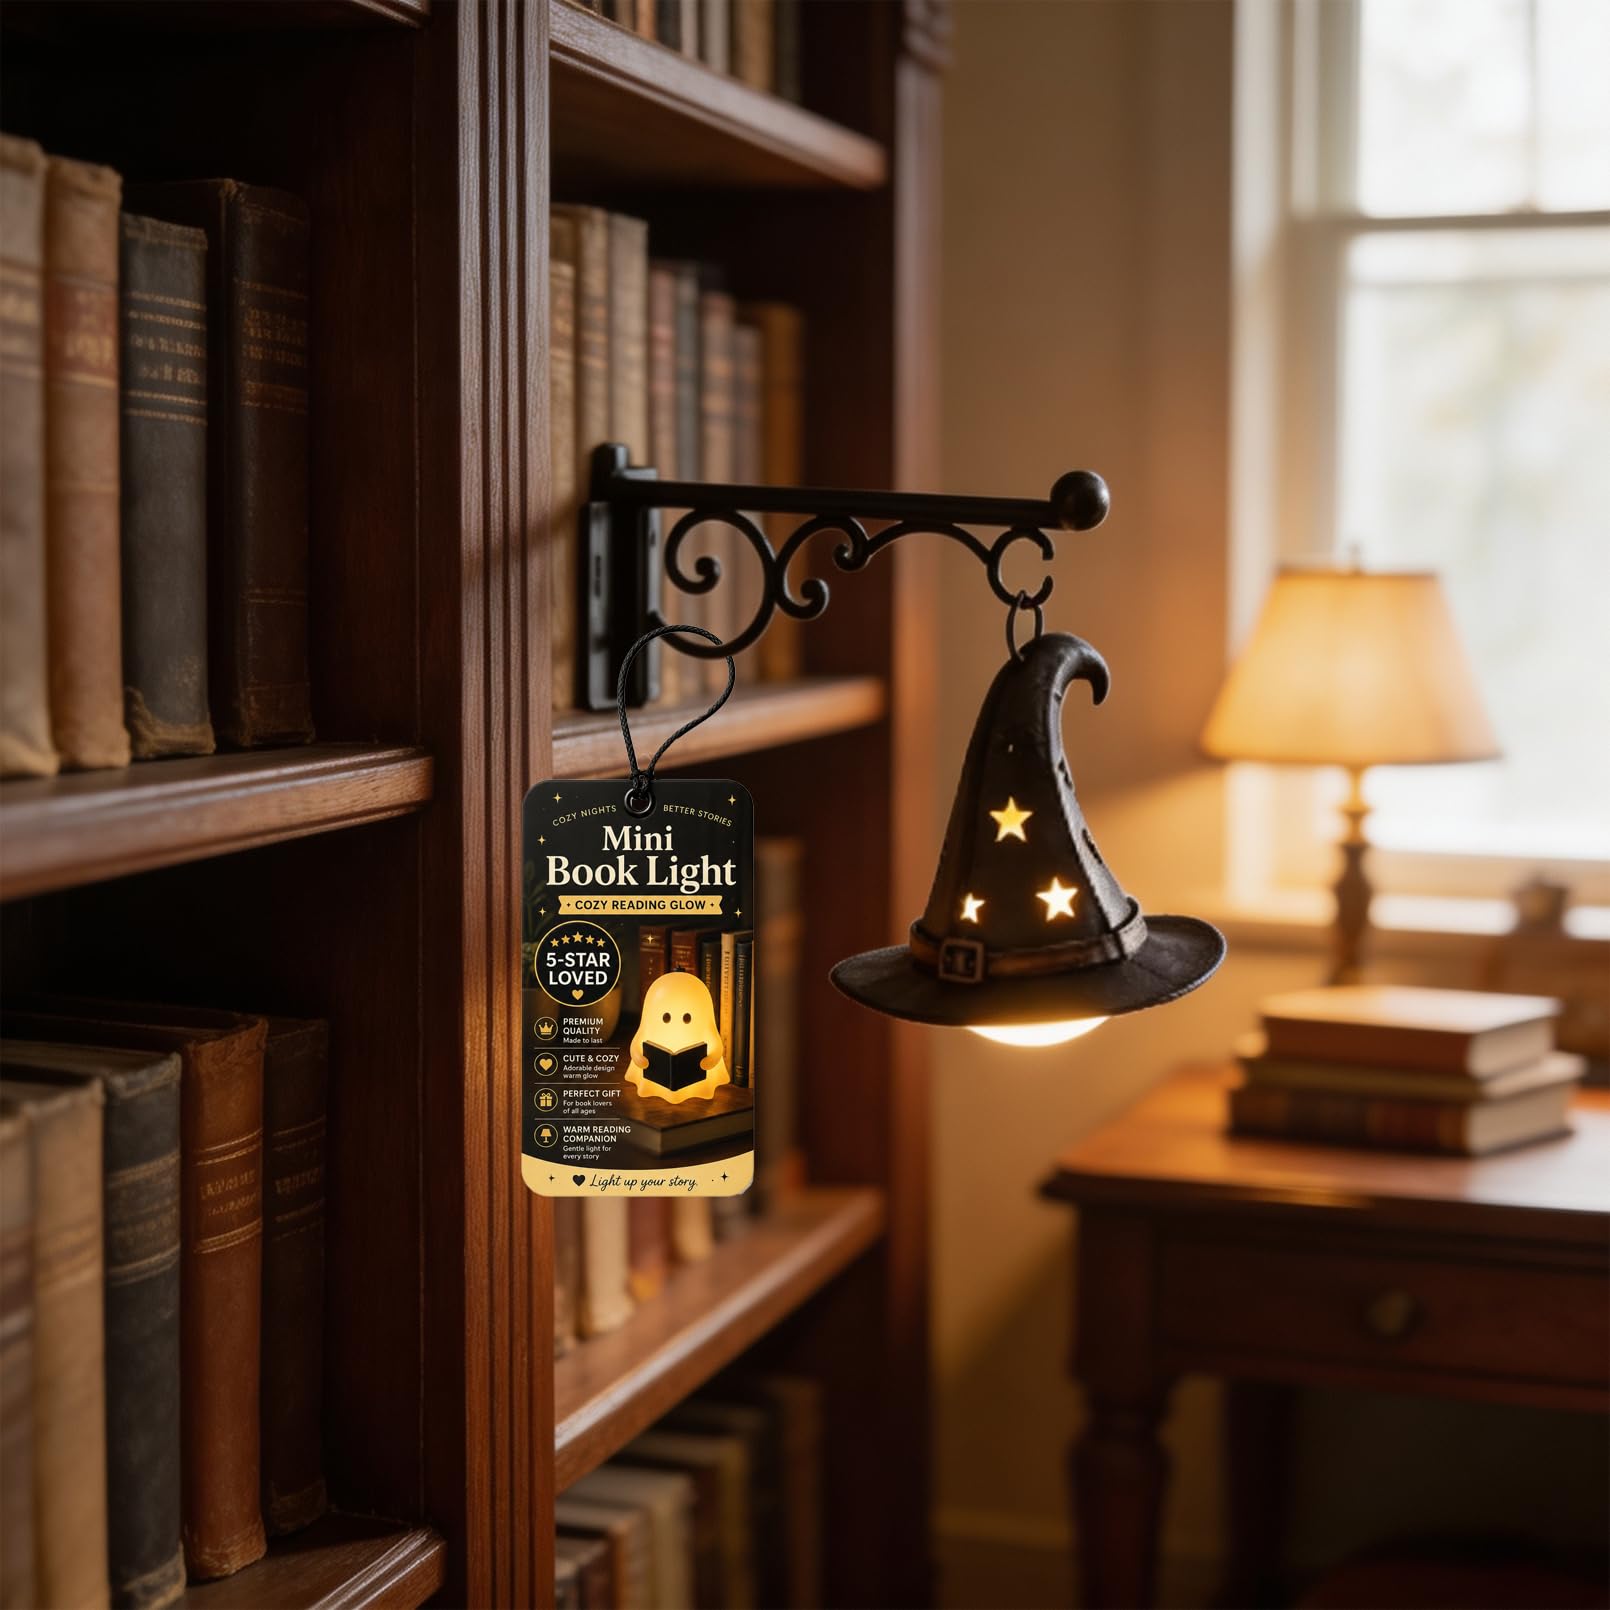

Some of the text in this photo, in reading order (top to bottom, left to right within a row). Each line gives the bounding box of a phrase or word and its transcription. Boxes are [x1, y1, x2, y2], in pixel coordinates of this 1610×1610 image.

[552, 805, 617, 827] COZY NIGHTS
[663, 804, 733, 827] BETTER STORIES
[602, 825, 673, 850] Mini
[546, 855, 736, 894] Book Light
[575, 900, 706, 909] COZY READING GLOW
[546, 952, 610, 967] 5-STAR
[549, 971, 608, 985] LOVED
[563, 1027, 600, 1035] QUALITY
[563, 1055, 619, 1063] CUTE & COZY
[563, 1135, 617, 1143] COMPANION
[586, 1145, 601, 1153] light
[590, 1174, 698, 1191] Light up your story.
